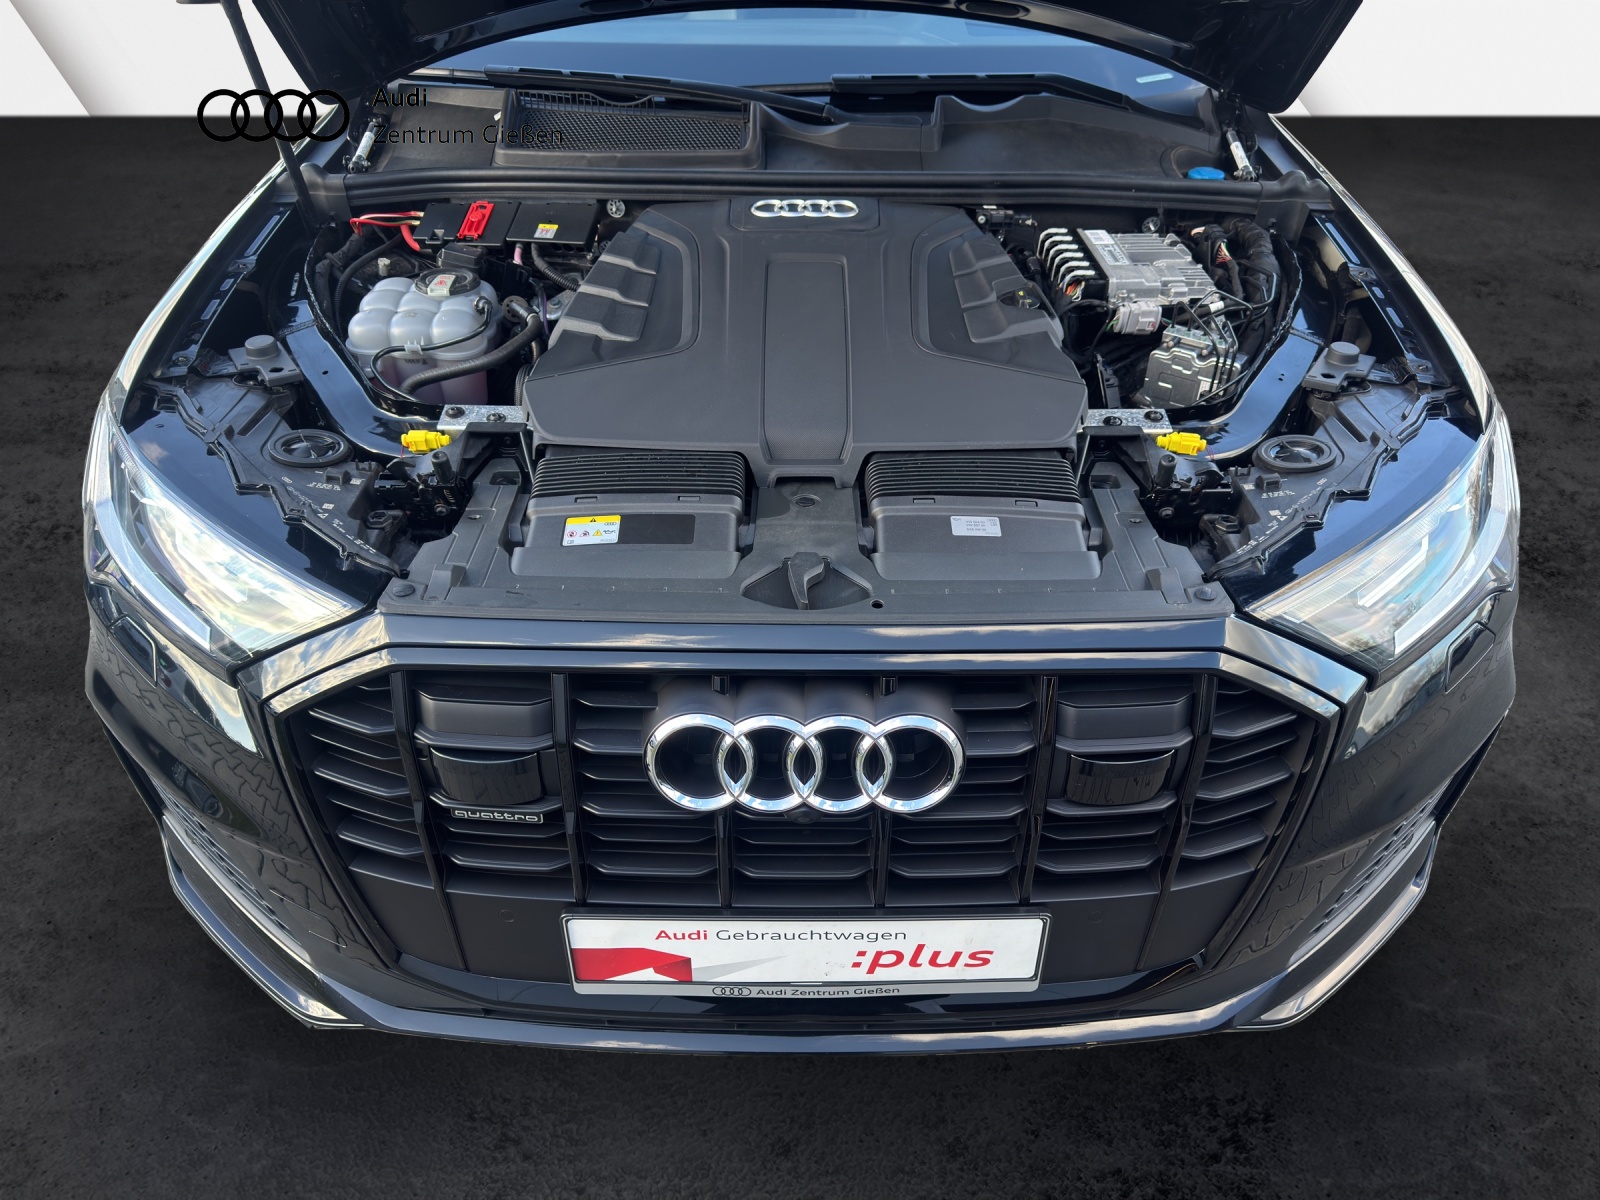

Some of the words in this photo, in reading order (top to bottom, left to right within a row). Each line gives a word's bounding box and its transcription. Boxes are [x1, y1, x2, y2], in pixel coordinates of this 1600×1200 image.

[455, 810, 538, 821] quattro
[655, 929, 708, 941] Audi
[716, 929, 907, 943] Gebrauchtwagen
[756, 988, 787, 996] Audi
[791, 988, 849, 996] Zentrum
[853, 987, 900, 996] Gießen
